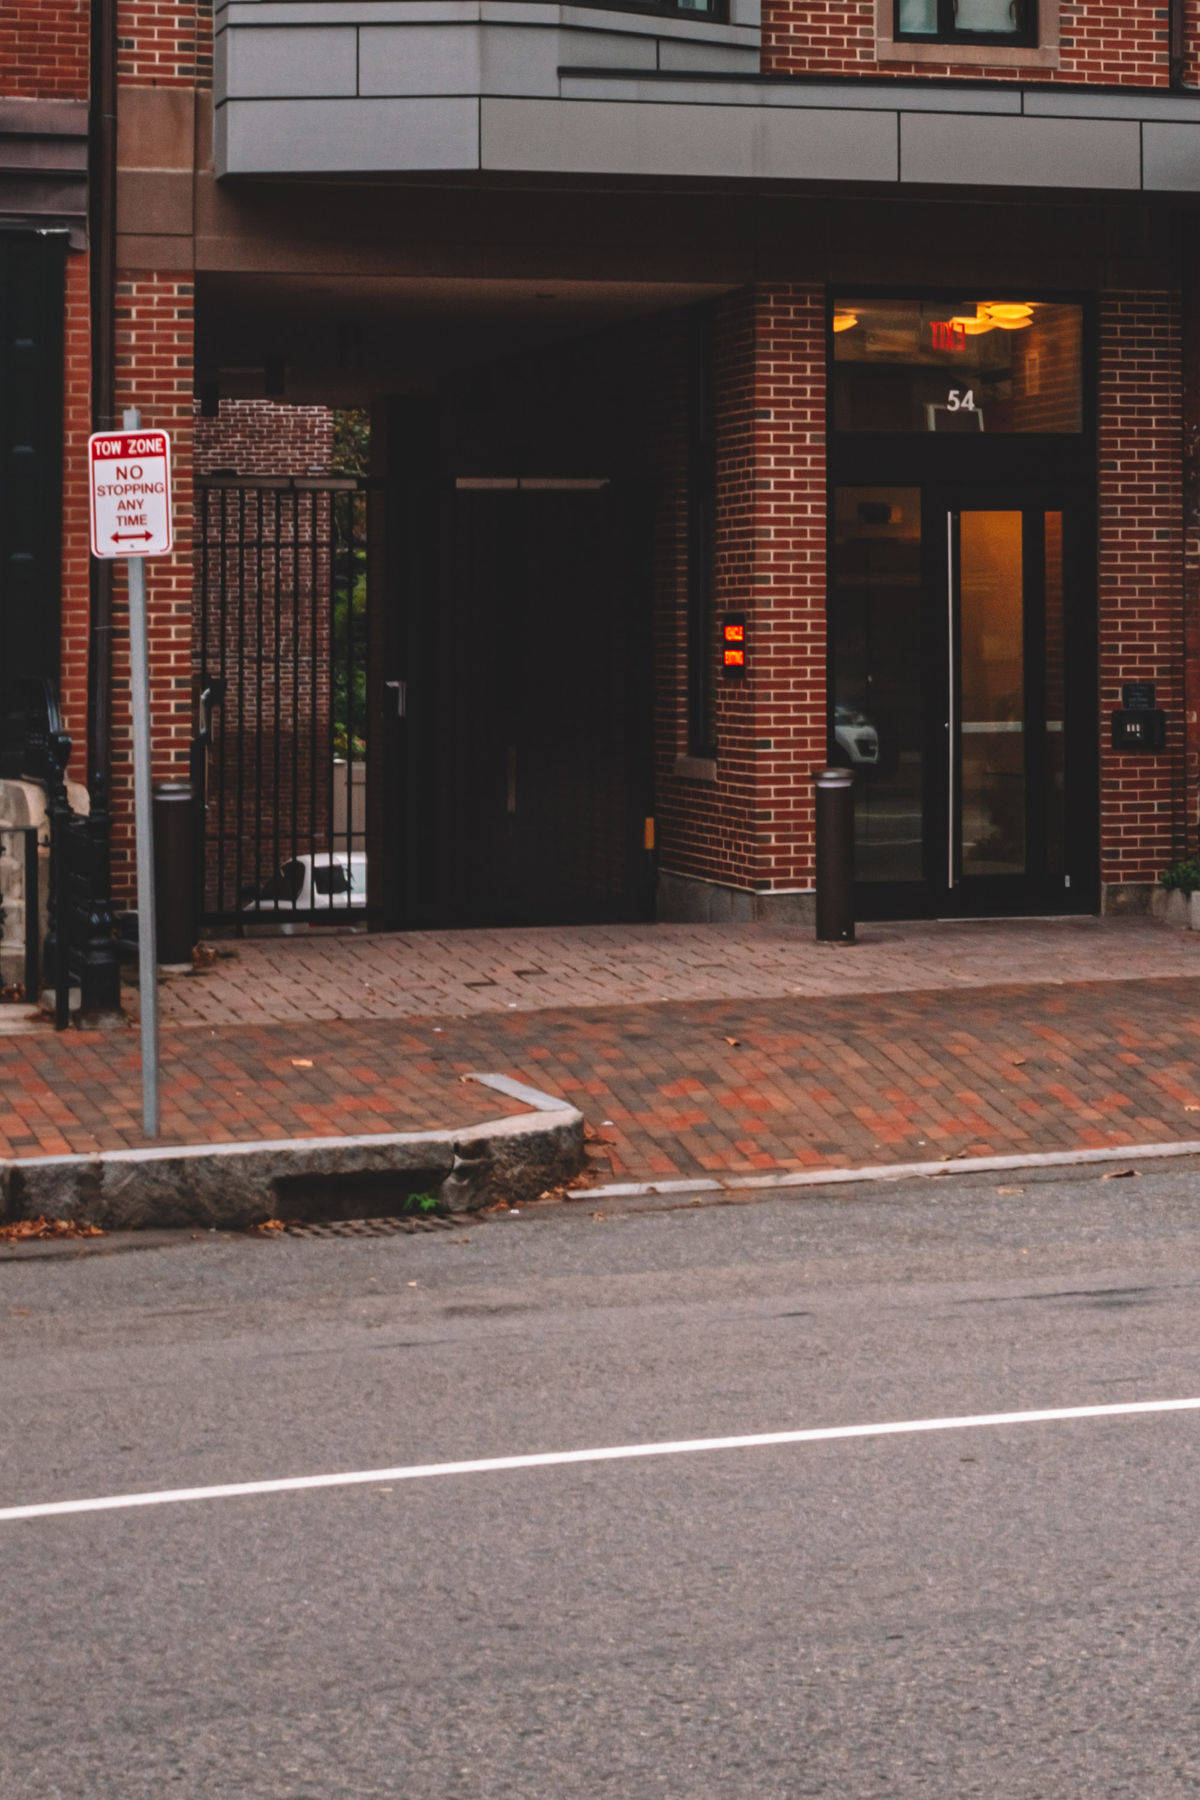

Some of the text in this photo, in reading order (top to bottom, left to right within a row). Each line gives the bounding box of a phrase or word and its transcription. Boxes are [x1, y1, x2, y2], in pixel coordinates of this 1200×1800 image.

[947, 390, 975, 411] 54
[94, 438, 164, 456] TOW ZONE
[116, 465, 143, 480] NO
[97, 482, 165, 497] STOPPING
[117, 499, 144, 511] ANY
[116, 514, 148, 527] TIME
